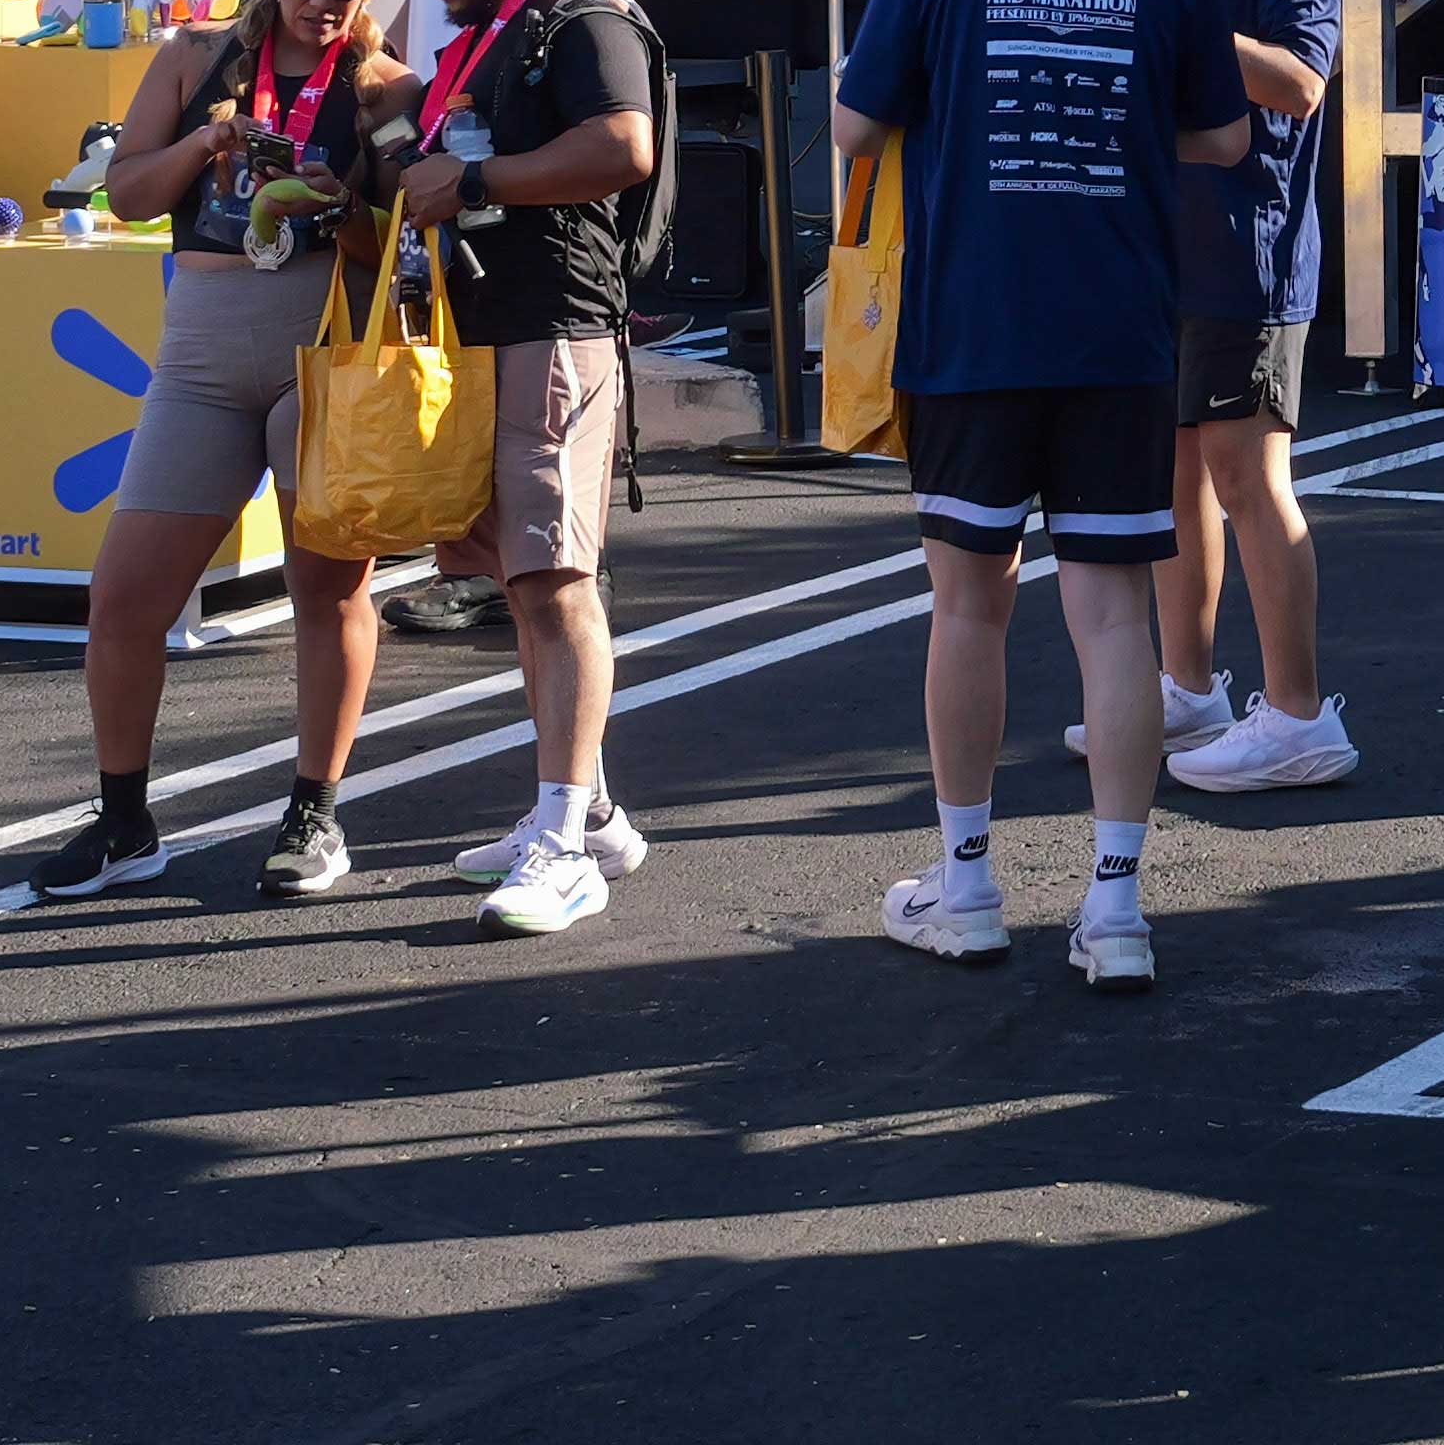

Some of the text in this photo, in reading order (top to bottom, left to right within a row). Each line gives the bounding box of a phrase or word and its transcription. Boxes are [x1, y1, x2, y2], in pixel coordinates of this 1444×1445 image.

[986, 8, 1135, 27] PRESENTED BY JPMorganChase
[1030, 131, 1058, 142] HOKA
